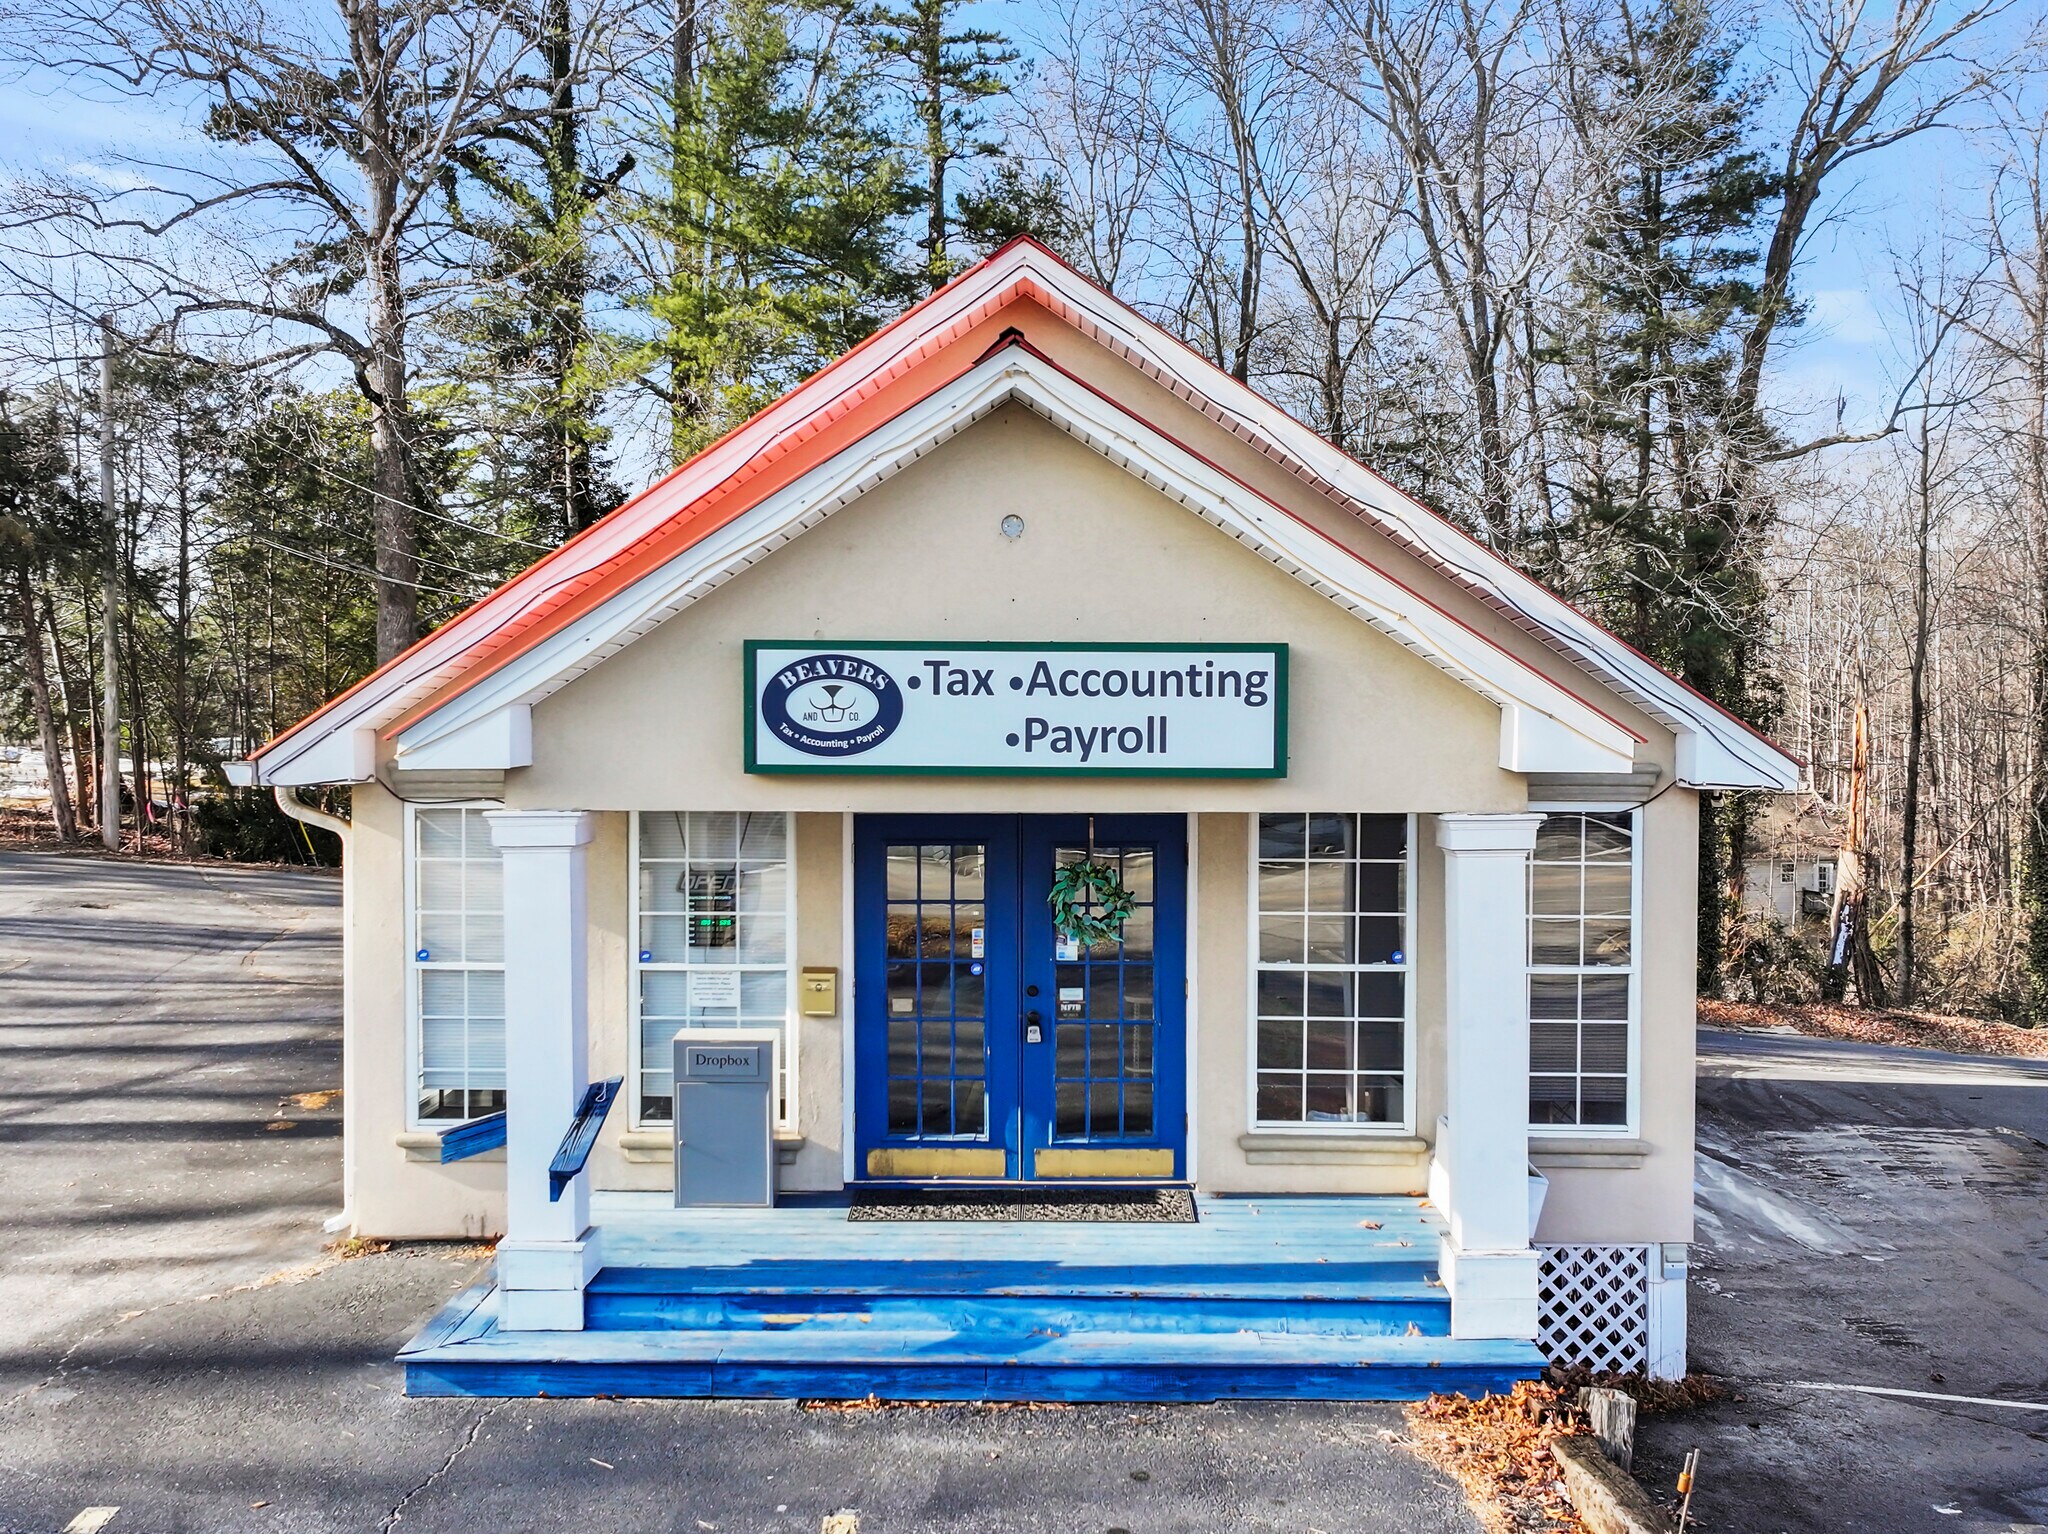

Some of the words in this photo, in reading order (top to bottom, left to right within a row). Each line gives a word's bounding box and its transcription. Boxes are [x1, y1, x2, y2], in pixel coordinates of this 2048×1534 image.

[778, 659, 890, 690] BEAVERS
[923, 660, 995, 696] Tax
[1025, 660, 1269, 707] Accounting
[802, 712, 818, 722] AND
[848, 712, 861, 722] CO.
[779, 722, 794, 738] Tax
[799, 735, 849, 749] Accounting
[856, 725, 885, 744] Payroll
[1024, 716, 1167, 762] Payroll
[695, 1053, 750, 1069] Dropbox
